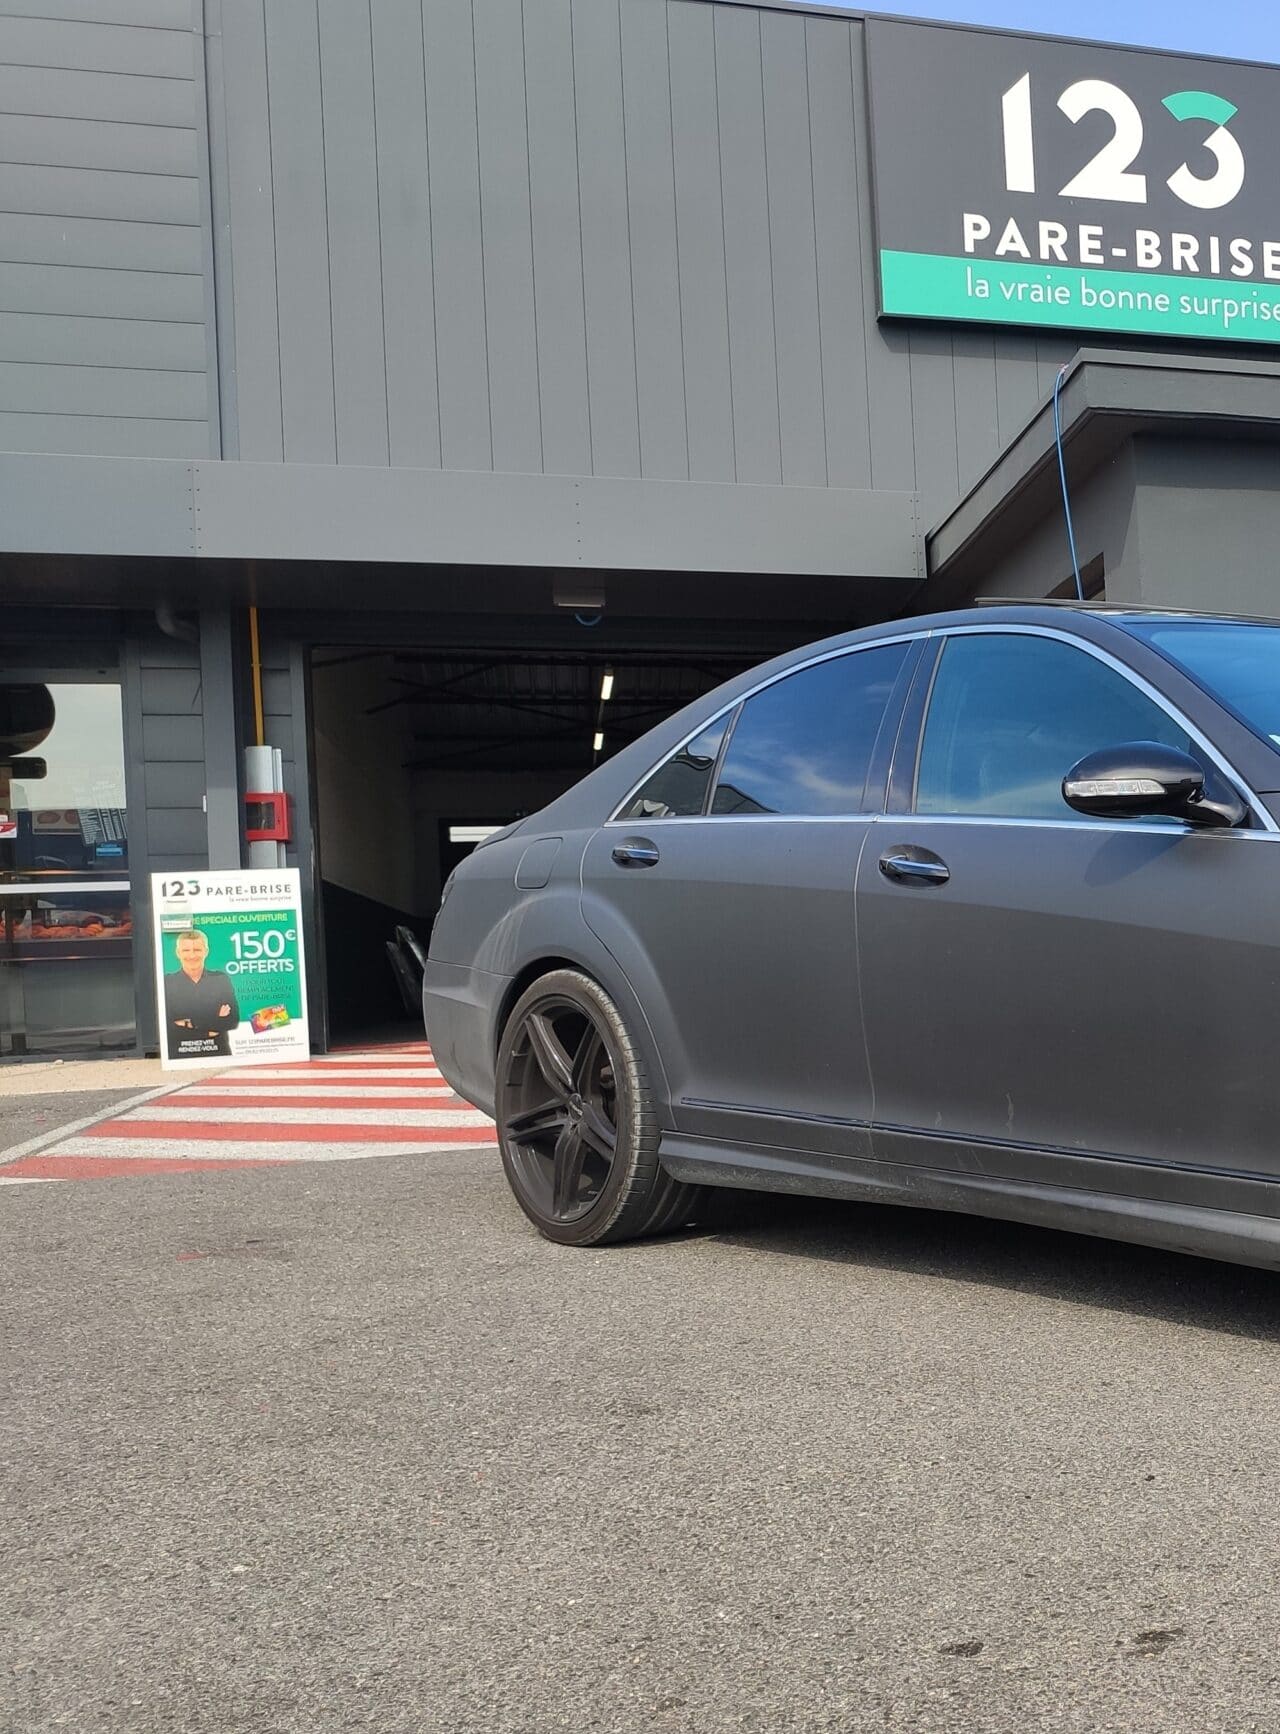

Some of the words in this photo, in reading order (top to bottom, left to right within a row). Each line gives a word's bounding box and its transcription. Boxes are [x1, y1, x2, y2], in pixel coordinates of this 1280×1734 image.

[1002, 72, 1246, 210] 123
[966, 266, 990, 300] la
[1000, 274, 1071, 306] vraie
[1081, 276, 1170, 314] bonne
[162, 880, 201, 897] 123
[206, 884, 292, 896] PARE-BRISE
[229, 928, 297, 960] 150€
[225, 958, 295, 975] OFFERTS
